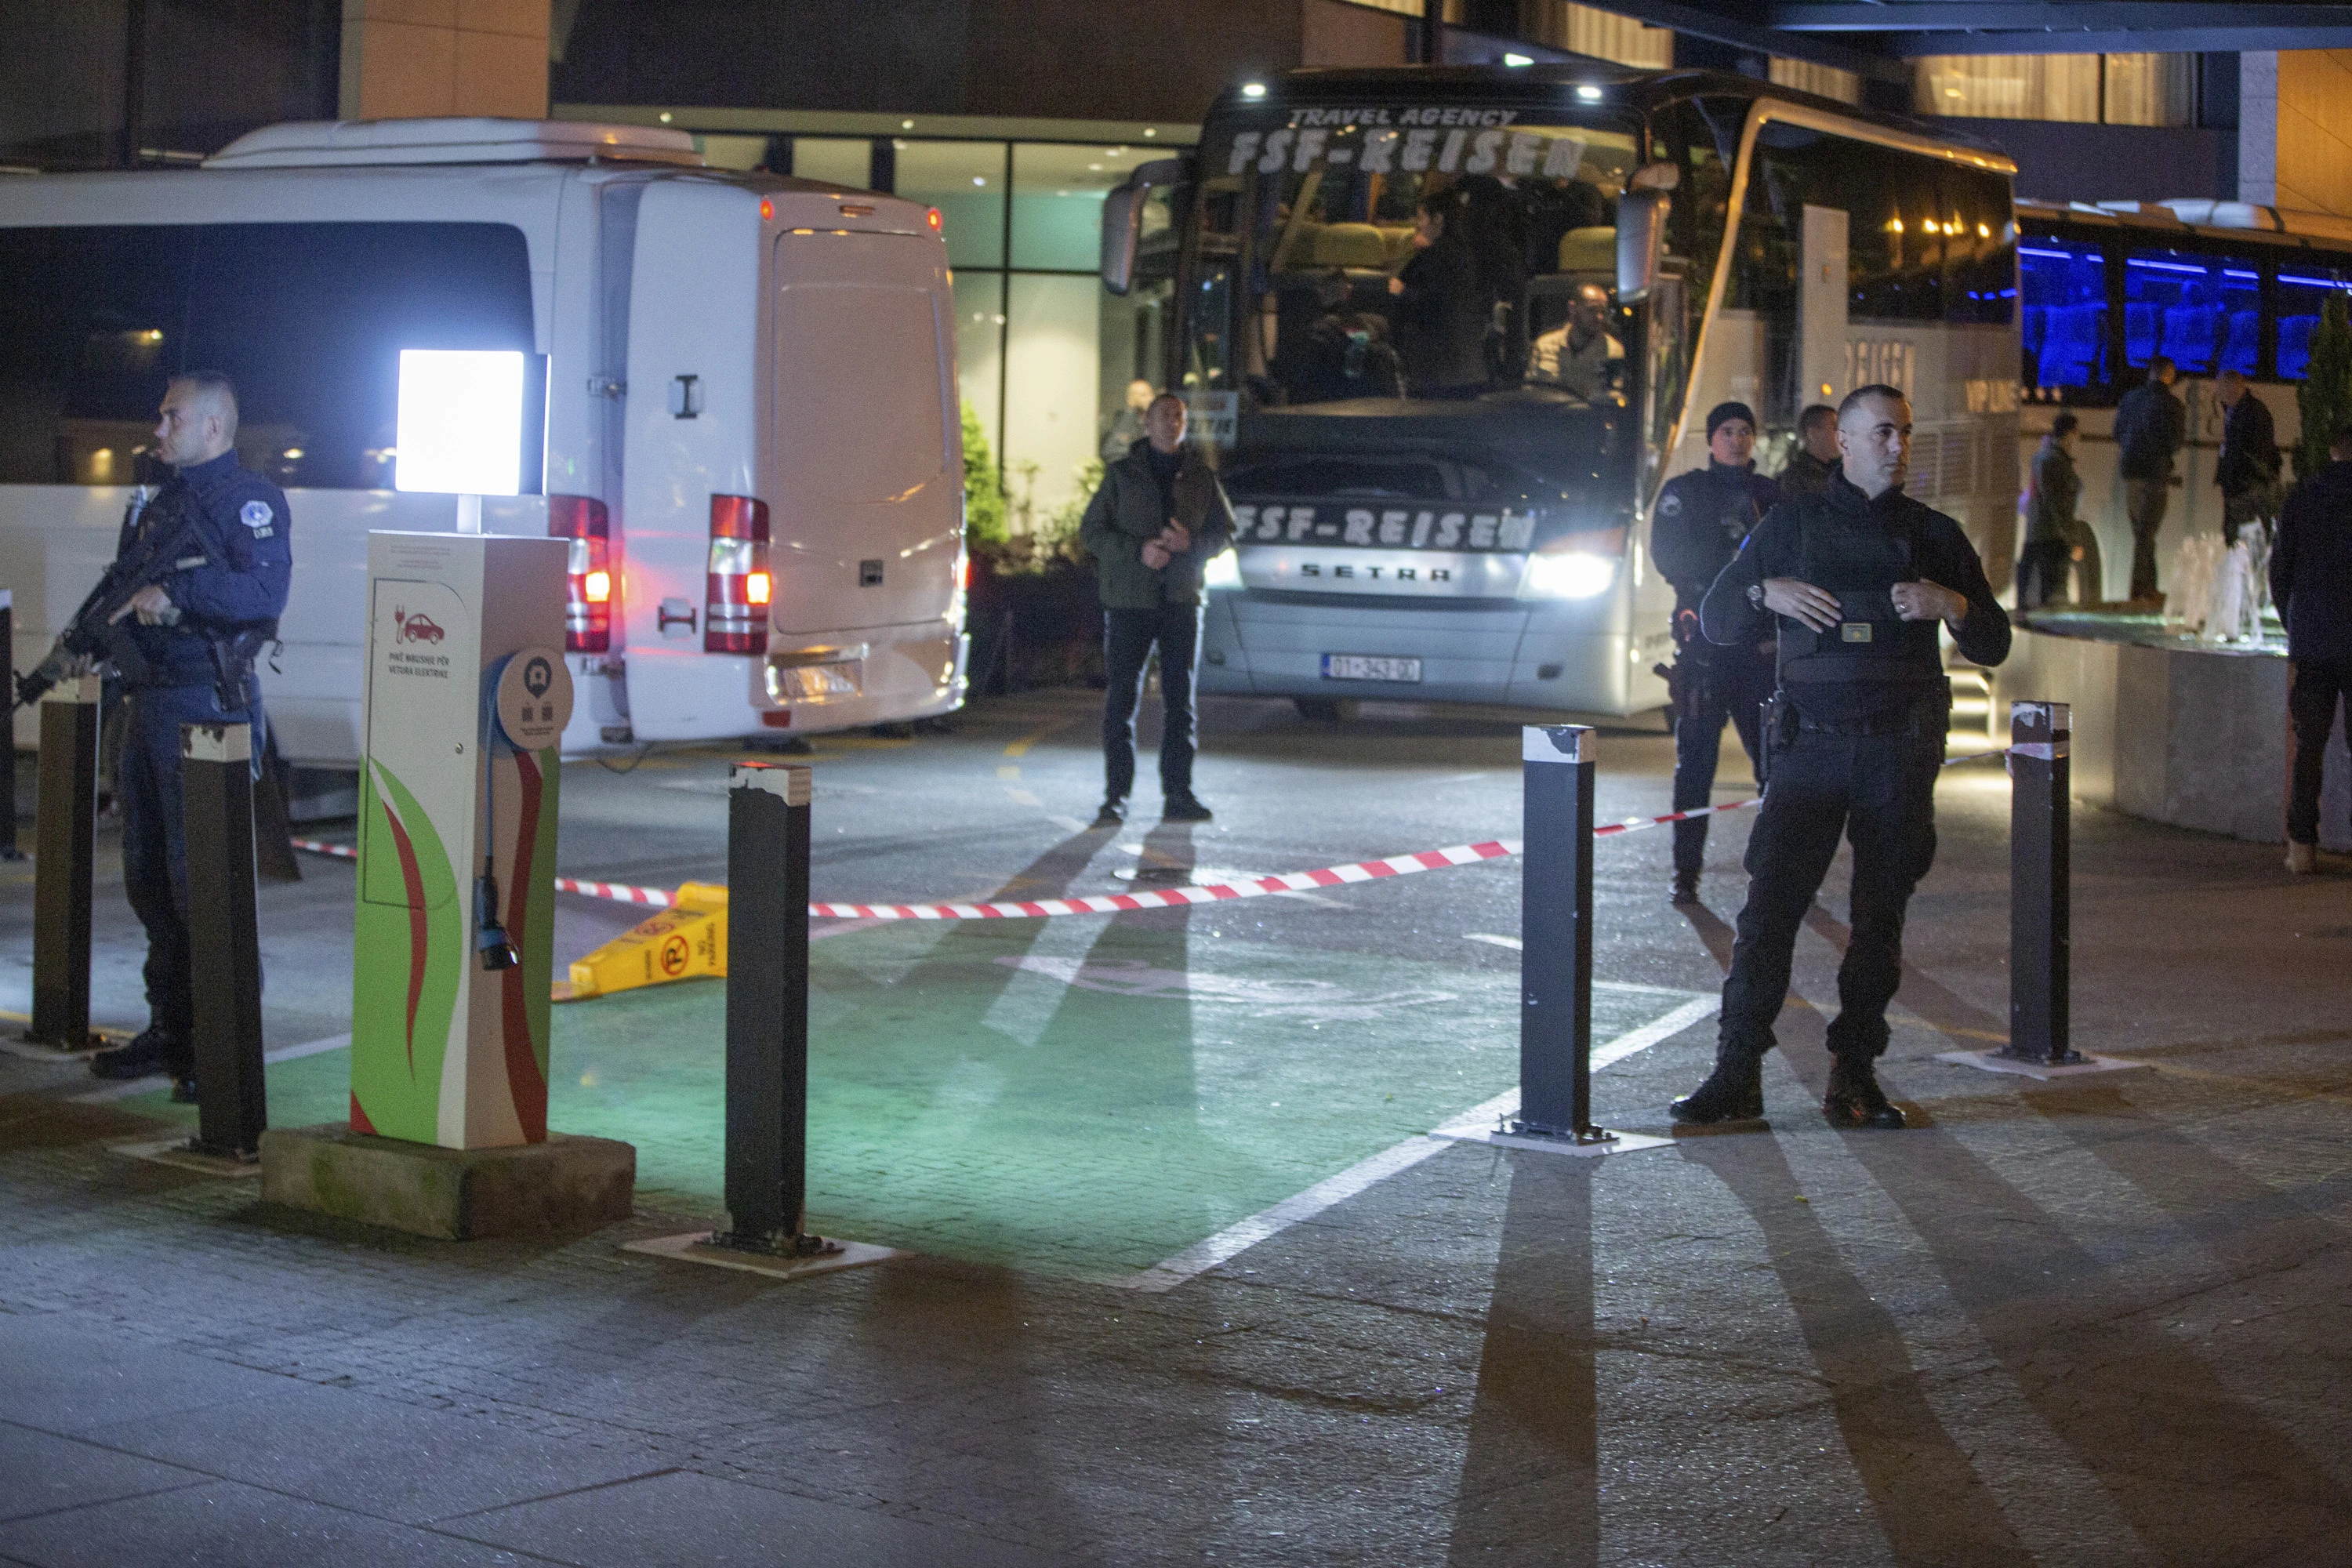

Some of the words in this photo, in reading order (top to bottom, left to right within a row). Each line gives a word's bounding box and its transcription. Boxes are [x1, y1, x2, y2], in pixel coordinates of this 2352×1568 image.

[1290, 108, 1393, 125] TRAVEL
[1399, 108, 1519, 127] AGENCY
[1228, 128, 1586, 177] FSF-REISEN
[1232, 506, 1536, 549] FSF-REISEN
[1301, 563, 1450, 583] SETRA
